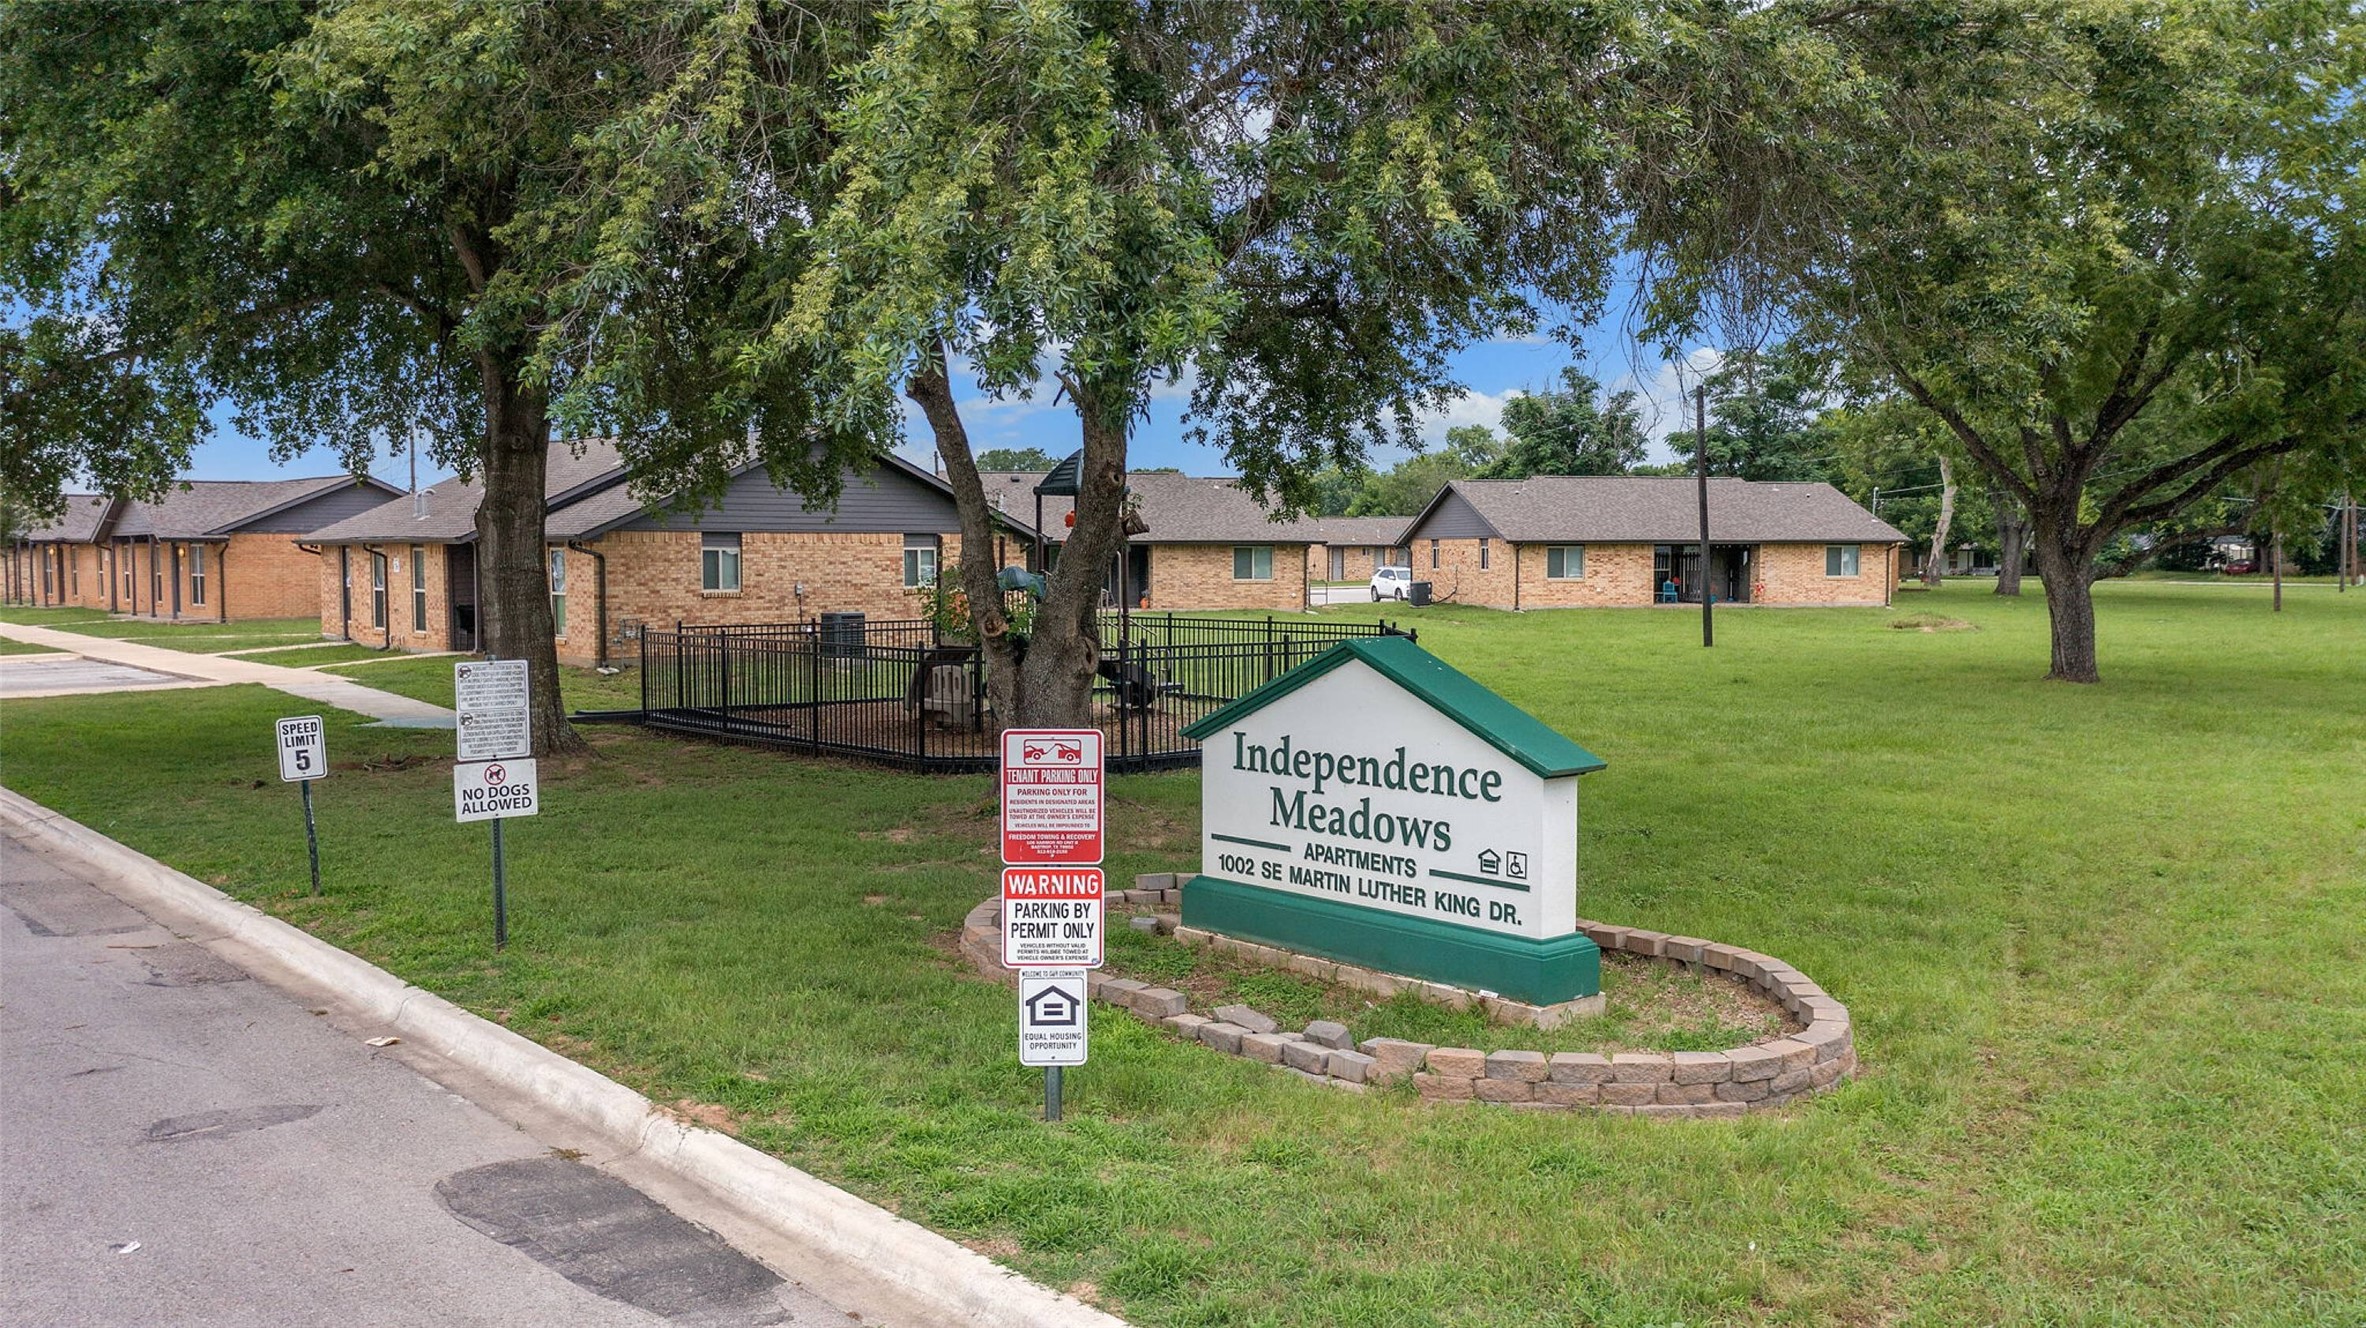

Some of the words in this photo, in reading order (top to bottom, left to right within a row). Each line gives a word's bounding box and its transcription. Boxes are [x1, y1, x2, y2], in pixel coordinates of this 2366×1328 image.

[282, 722, 317, 735] SPEED
[285, 734, 316, 747] LIMIT
[296, 750, 310, 770] 5
[1233, 731, 1503, 802] Independence
[1006, 769, 1039, 783] TENANT
[1041, 769, 1076, 783] PARKING
[1078, 769, 1098, 783] ONLY
[463, 788, 484, 801] NO
[488, 784, 530, 798] DOGS
[462, 796, 532, 815] ALLOWED
[1270, 786, 1452, 851] Meadows
[1304, 843, 1417, 878] APARTMENTS
[1008, 874, 1099, 895] WARNING
[1218, 853, 1255, 875] 1002
[1262, 863, 1282, 881] SE
[1290, 866, 1351, 894] MARTIN
[1358, 878, 1426, 908] LUTHER
[1434, 891, 1480, 918] KING
[1489, 900, 1523, 926] DR.
[1015, 903, 1069, 918] PARKING
[1074, 903, 1091, 918] BY
[1011, 923, 1058, 938] PERMIT
[1064, 923, 1095, 938] ONLY
[1050, 1032, 1082, 1040] HOUSING
[1030, 1042, 1077, 1050] OPPORTUNITY
